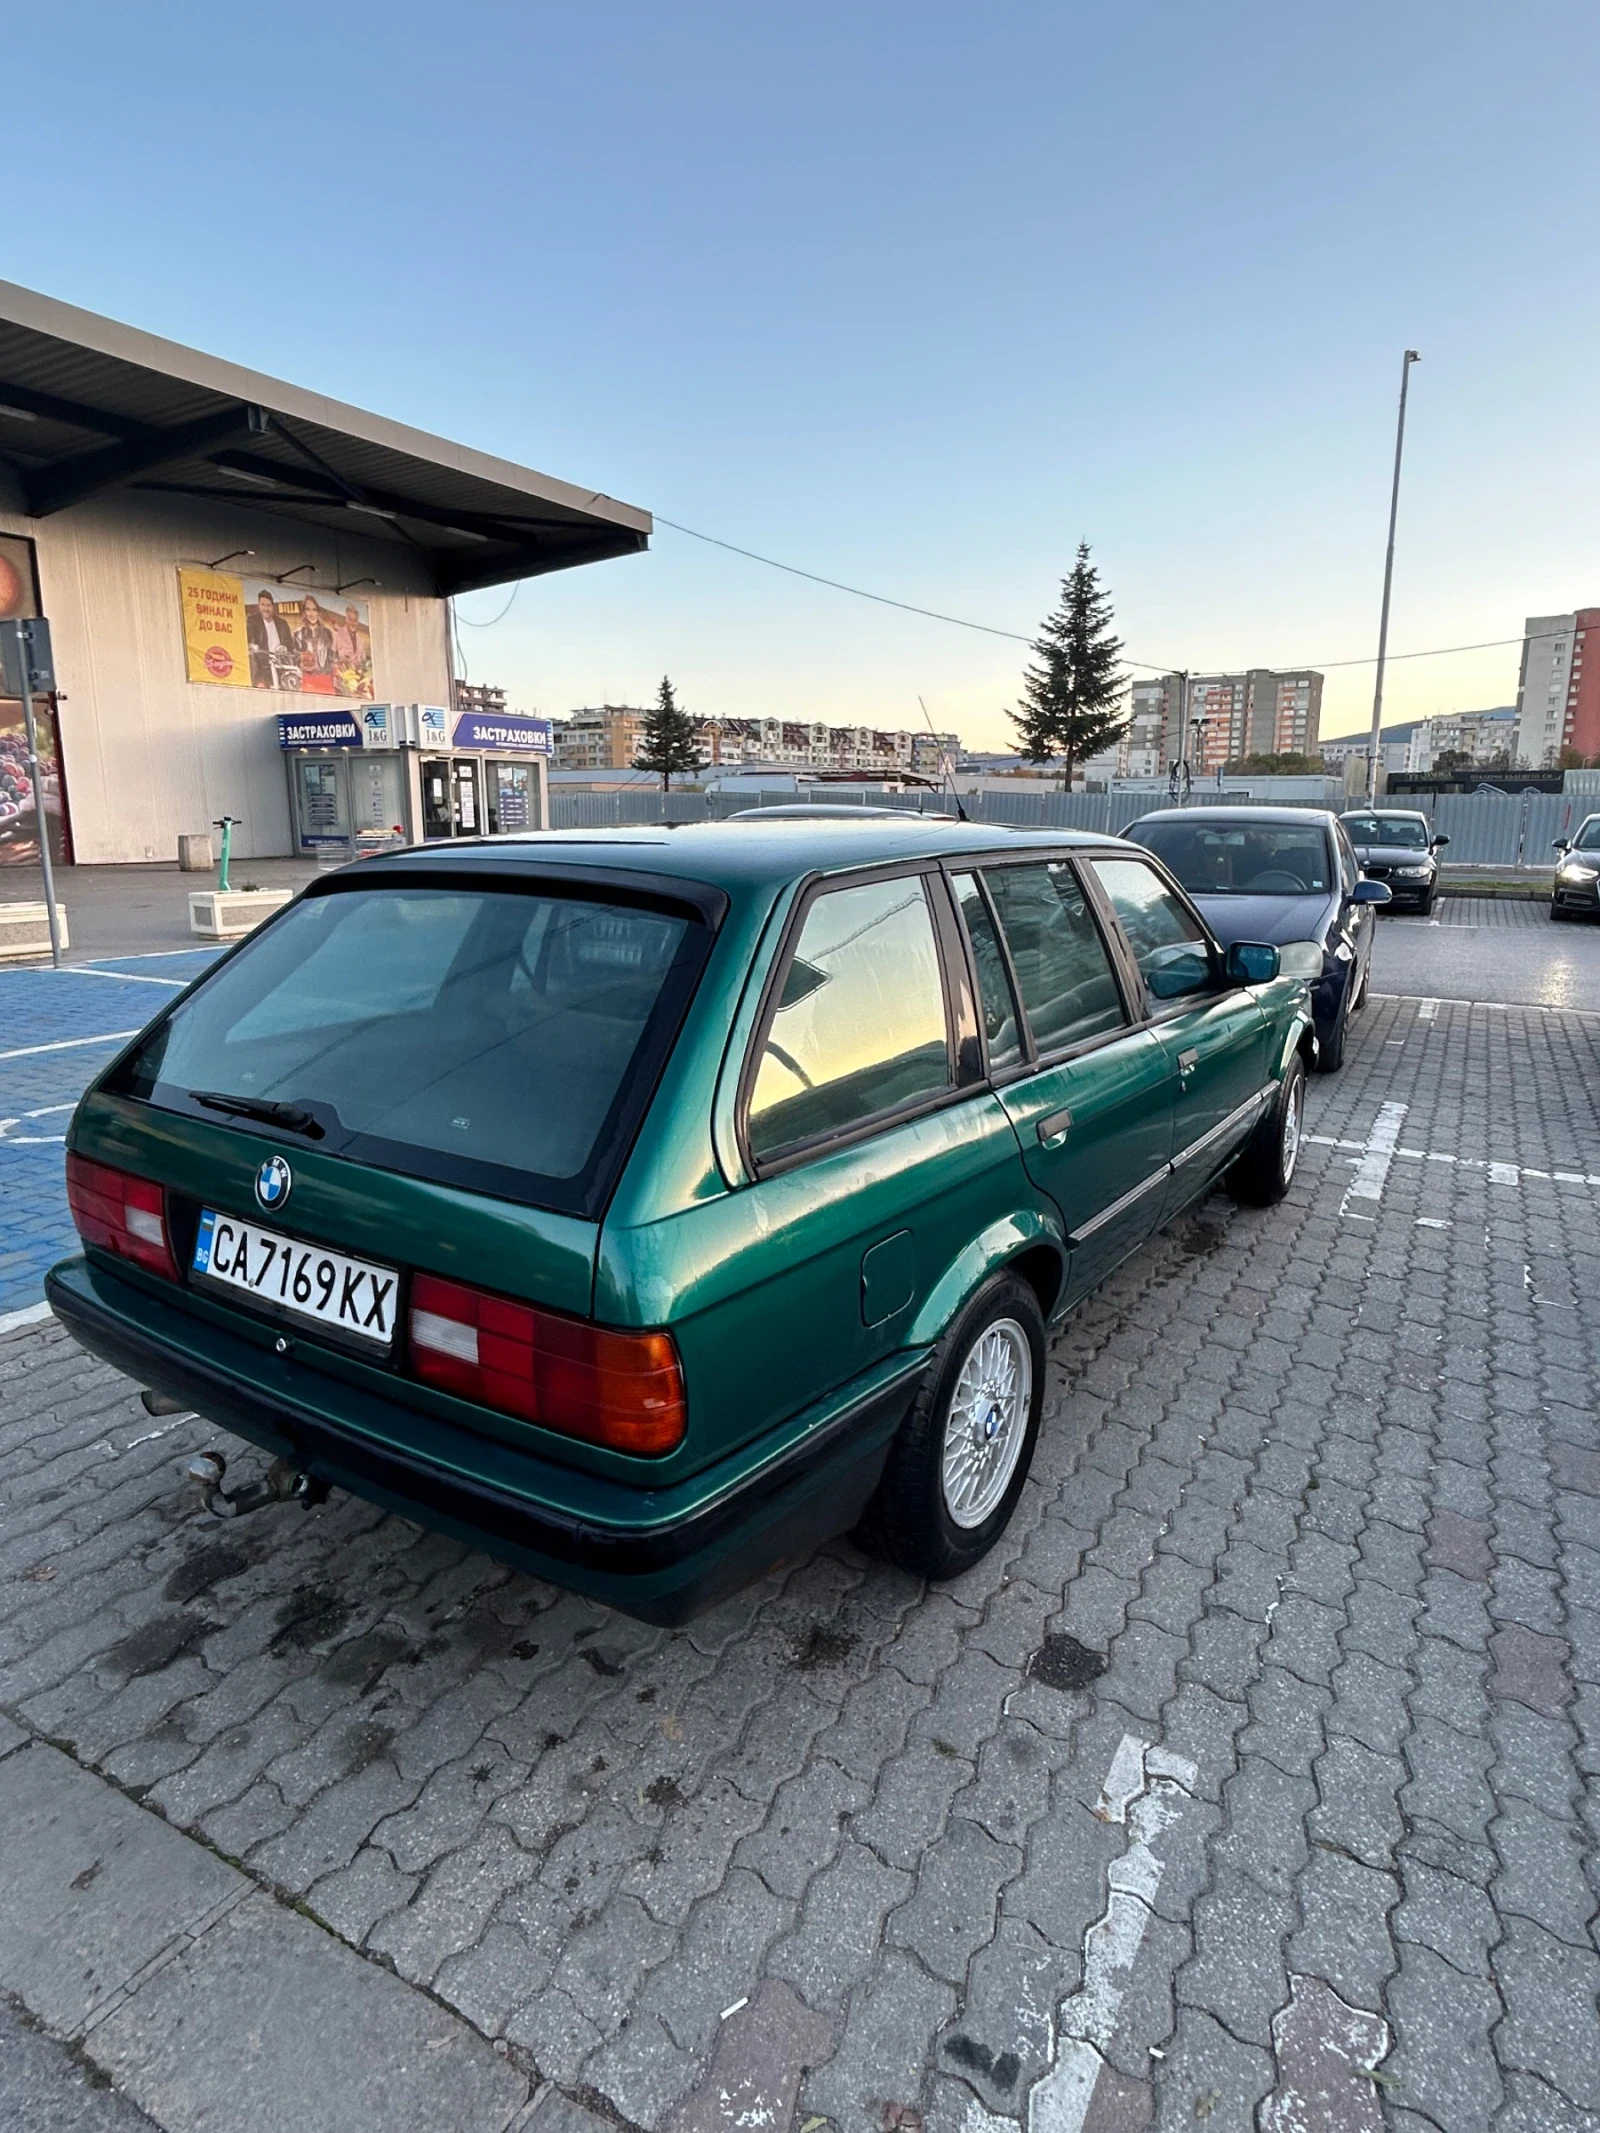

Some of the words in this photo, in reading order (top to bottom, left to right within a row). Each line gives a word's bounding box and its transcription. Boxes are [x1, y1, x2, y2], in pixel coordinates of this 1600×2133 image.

[187, 586, 199, 598] 25
[200, 588, 239, 605] ГОДИНИ
[196, 603, 233, 619] ВИНАГИ
[199, 619, 213, 632] ДО
[214, 621, 233, 634] ВАС
[287, 723, 356, 740] ЗАСТРАХОВКИ
[473, 726, 546, 745] ЗАСТРАХОВКИ
[261, 1158, 288, 1178] BMW
[196, 1247, 209, 1264] BG
[213, 1223, 394, 1333] CA7169KX
